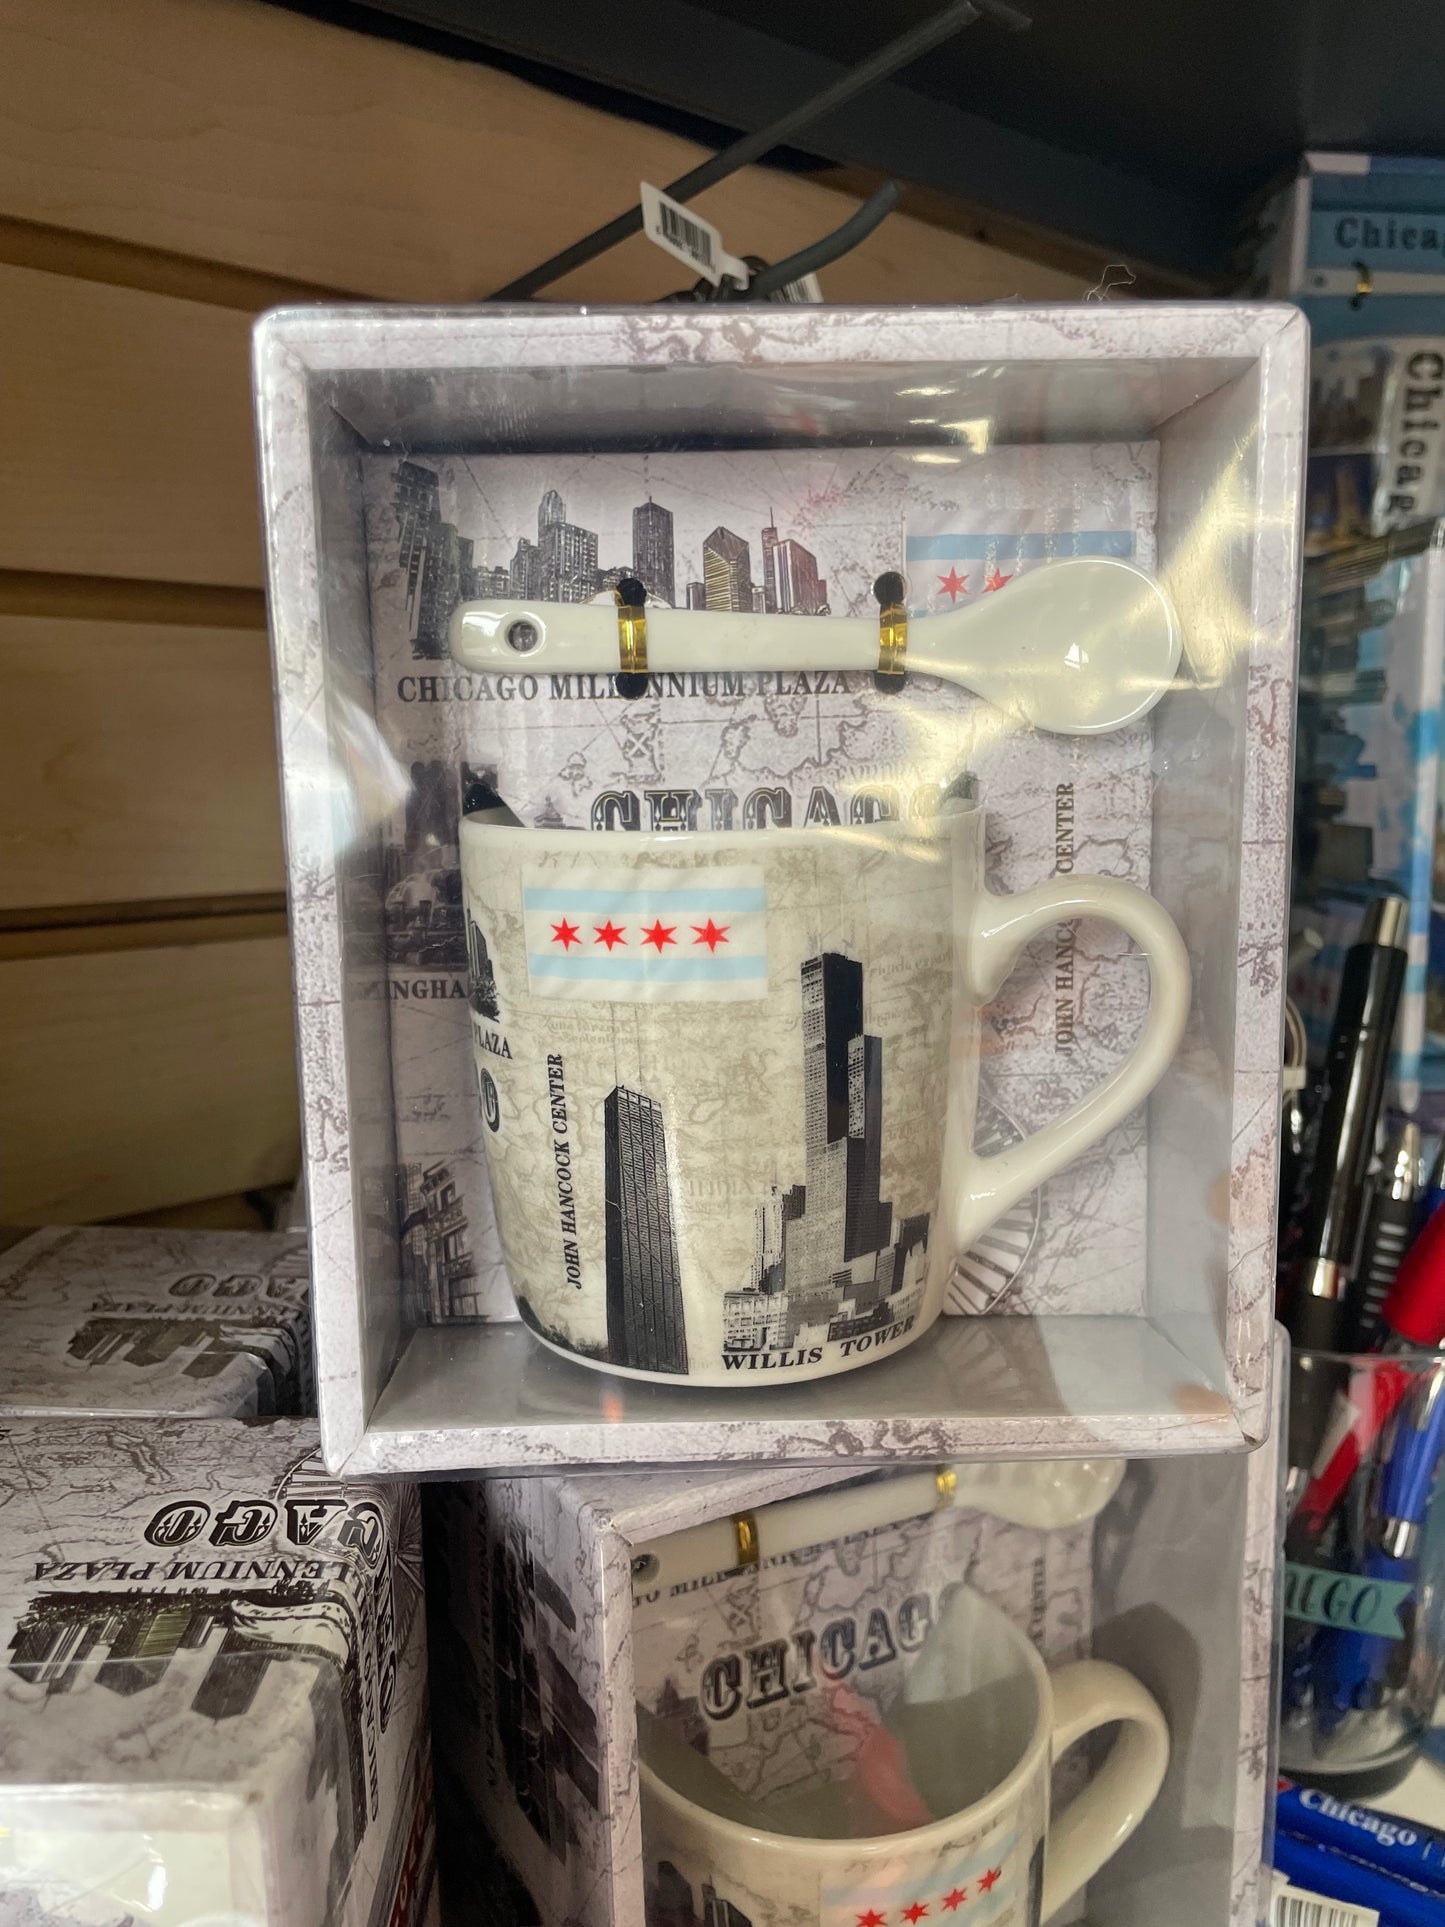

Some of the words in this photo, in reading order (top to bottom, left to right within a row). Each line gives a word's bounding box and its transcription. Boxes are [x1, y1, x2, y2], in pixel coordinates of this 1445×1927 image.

[1335, 217, 1445, 251] Chica
[1389, 353, 1443, 512] Chicag
[397, 675, 539, 703] CHICAGO
[549, 671, 745, 700] MILLNNIUM
[755, 670, 851, 696] PLAZA
[1055, 782, 1075, 874] CENTER
[1054, 917, 1075, 991] HANC
[1054, 999, 1075, 1057] JOHN
[547, 1053, 568, 1135] CENTER
[554, 1138, 578, 1236] HANCOCK
[564, 1239, 582, 1291] JOHN
[721, 1346, 823, 1371] WILLIS
[840, 1314, 916, 1358] TOWER
[33, 1560, 156, 1583] PLAZA
[702, 1591, 940, 1722] CHICAG
[1299, 1789, 1418, 1847] Chicago
